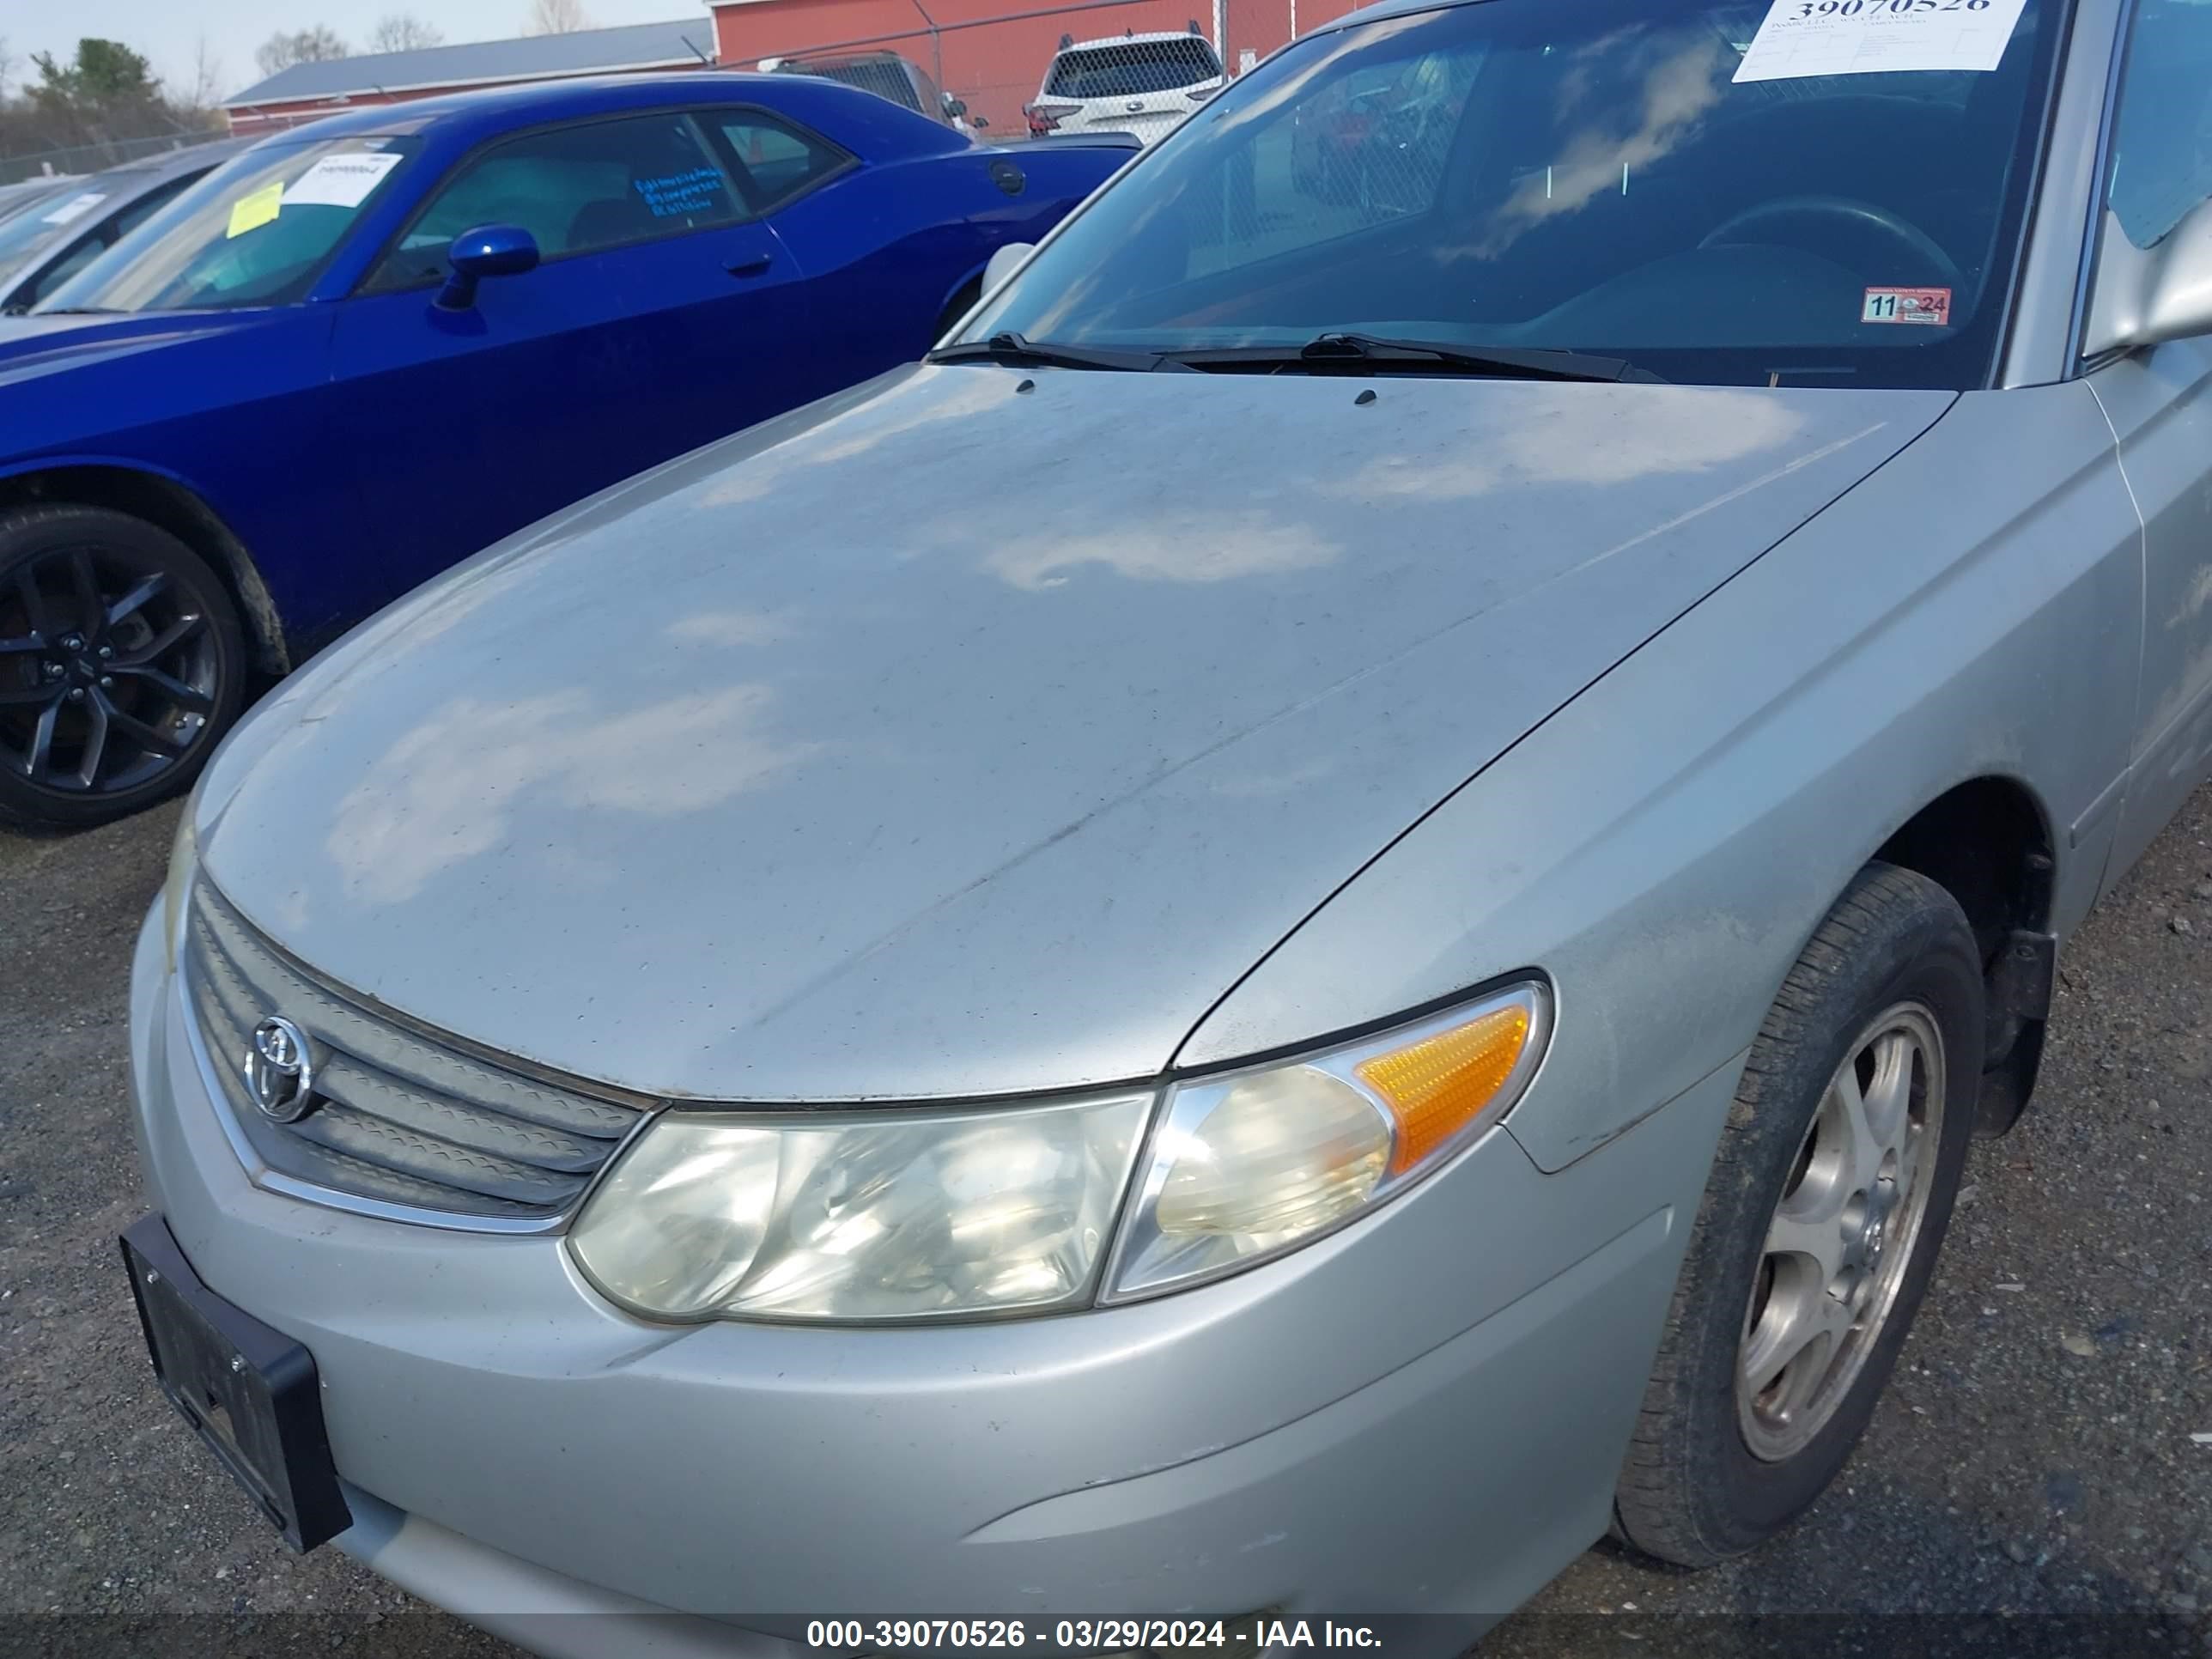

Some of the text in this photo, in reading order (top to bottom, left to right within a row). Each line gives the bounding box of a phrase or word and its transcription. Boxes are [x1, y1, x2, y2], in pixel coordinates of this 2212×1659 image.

[1789, 0, 1990, 21] 39070526
[1872, 295, 1947, 317] 11 24
